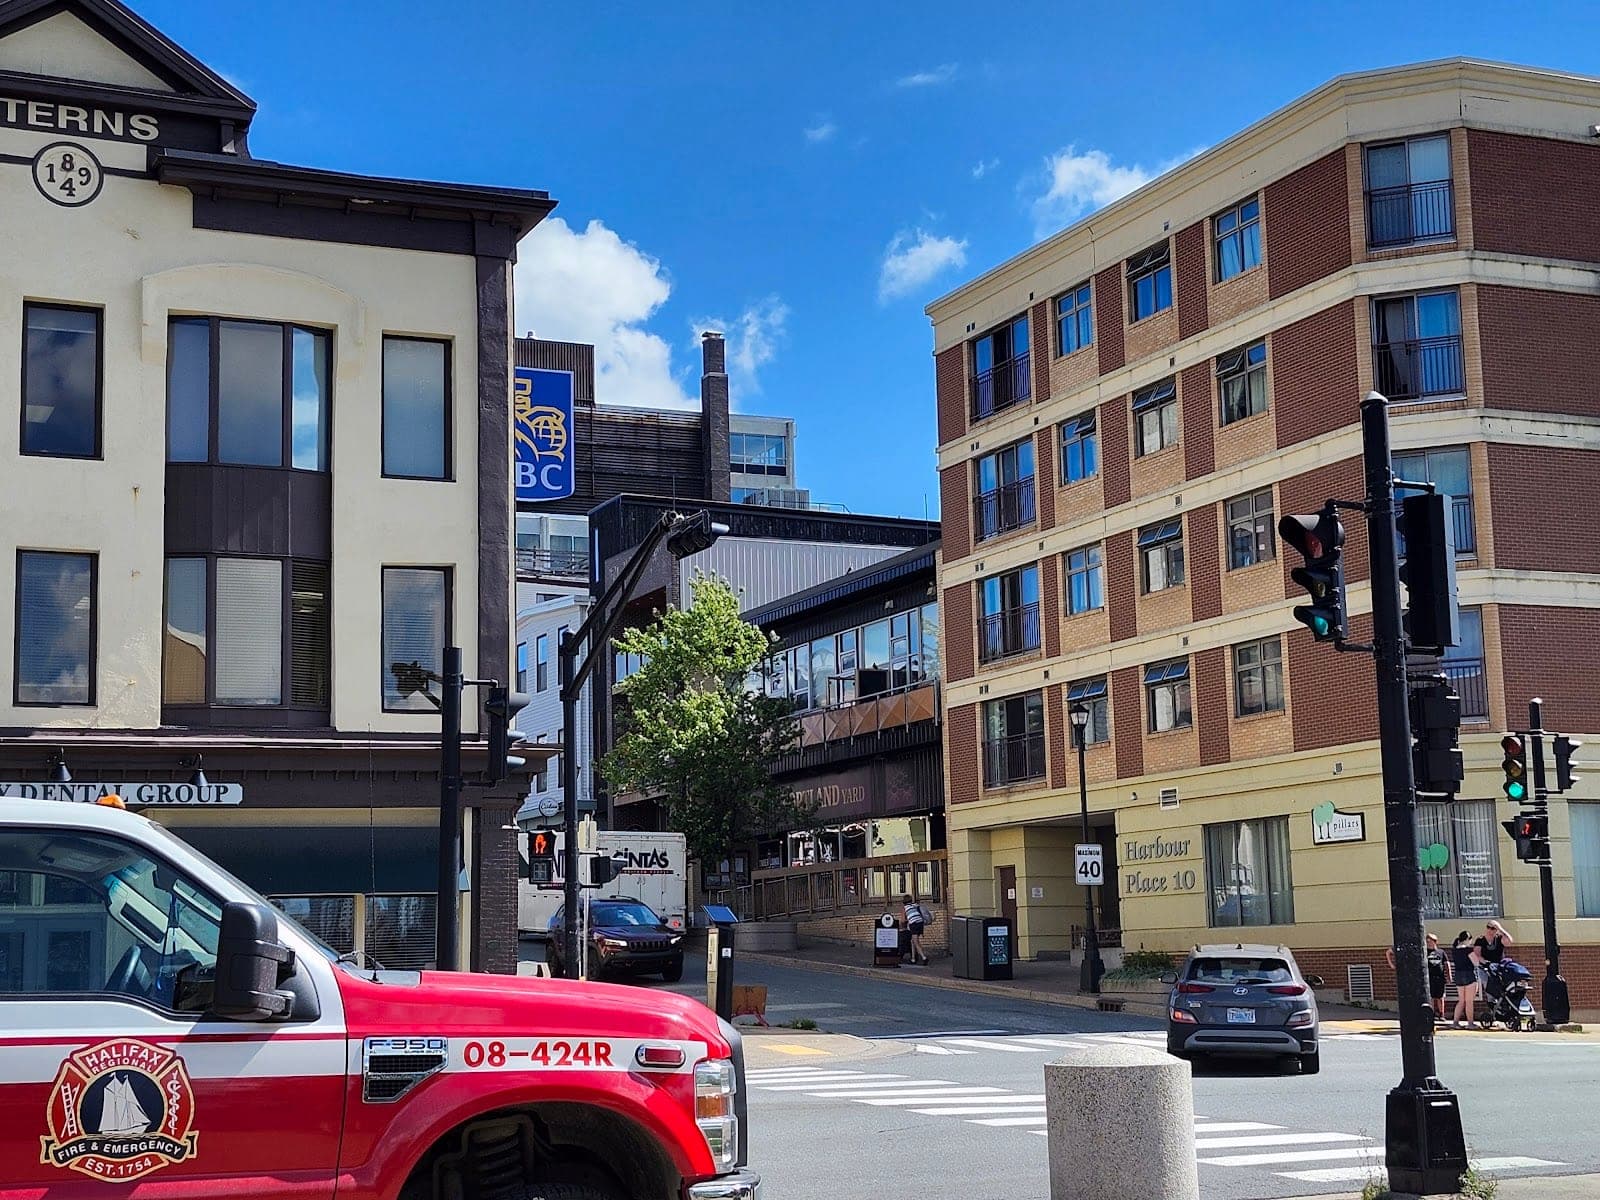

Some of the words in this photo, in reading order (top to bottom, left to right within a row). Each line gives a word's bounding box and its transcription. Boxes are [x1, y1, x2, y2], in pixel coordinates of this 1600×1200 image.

[0, 98, 159, 141] TERNS
[20, 784, 129, 802] DENTAL
[137, 784, 229, 803] GROUP
[841, 786, 865, 804] YARD
[1333, 818, 1359, 833] pillars
[1124, 836, 1191, 861] Harbour
[1078, 860, 1101, 878] 40
[1125, 871, 1168, 894] Place
[1173, 870, 1196, 891] 10
[369, 1039, 443, 1050] F-350
[463, 1041, 614, 1068] 08-424R
[85, 1044, 162, 1068] HALIFAX
[91, 1057, 153, 1074] REGIONAL
[57, 1142, 87, 1161] FIRE
[90, 1141, 99, 1151] &
[103, 1140, 182, 1156] EMERGENCY
